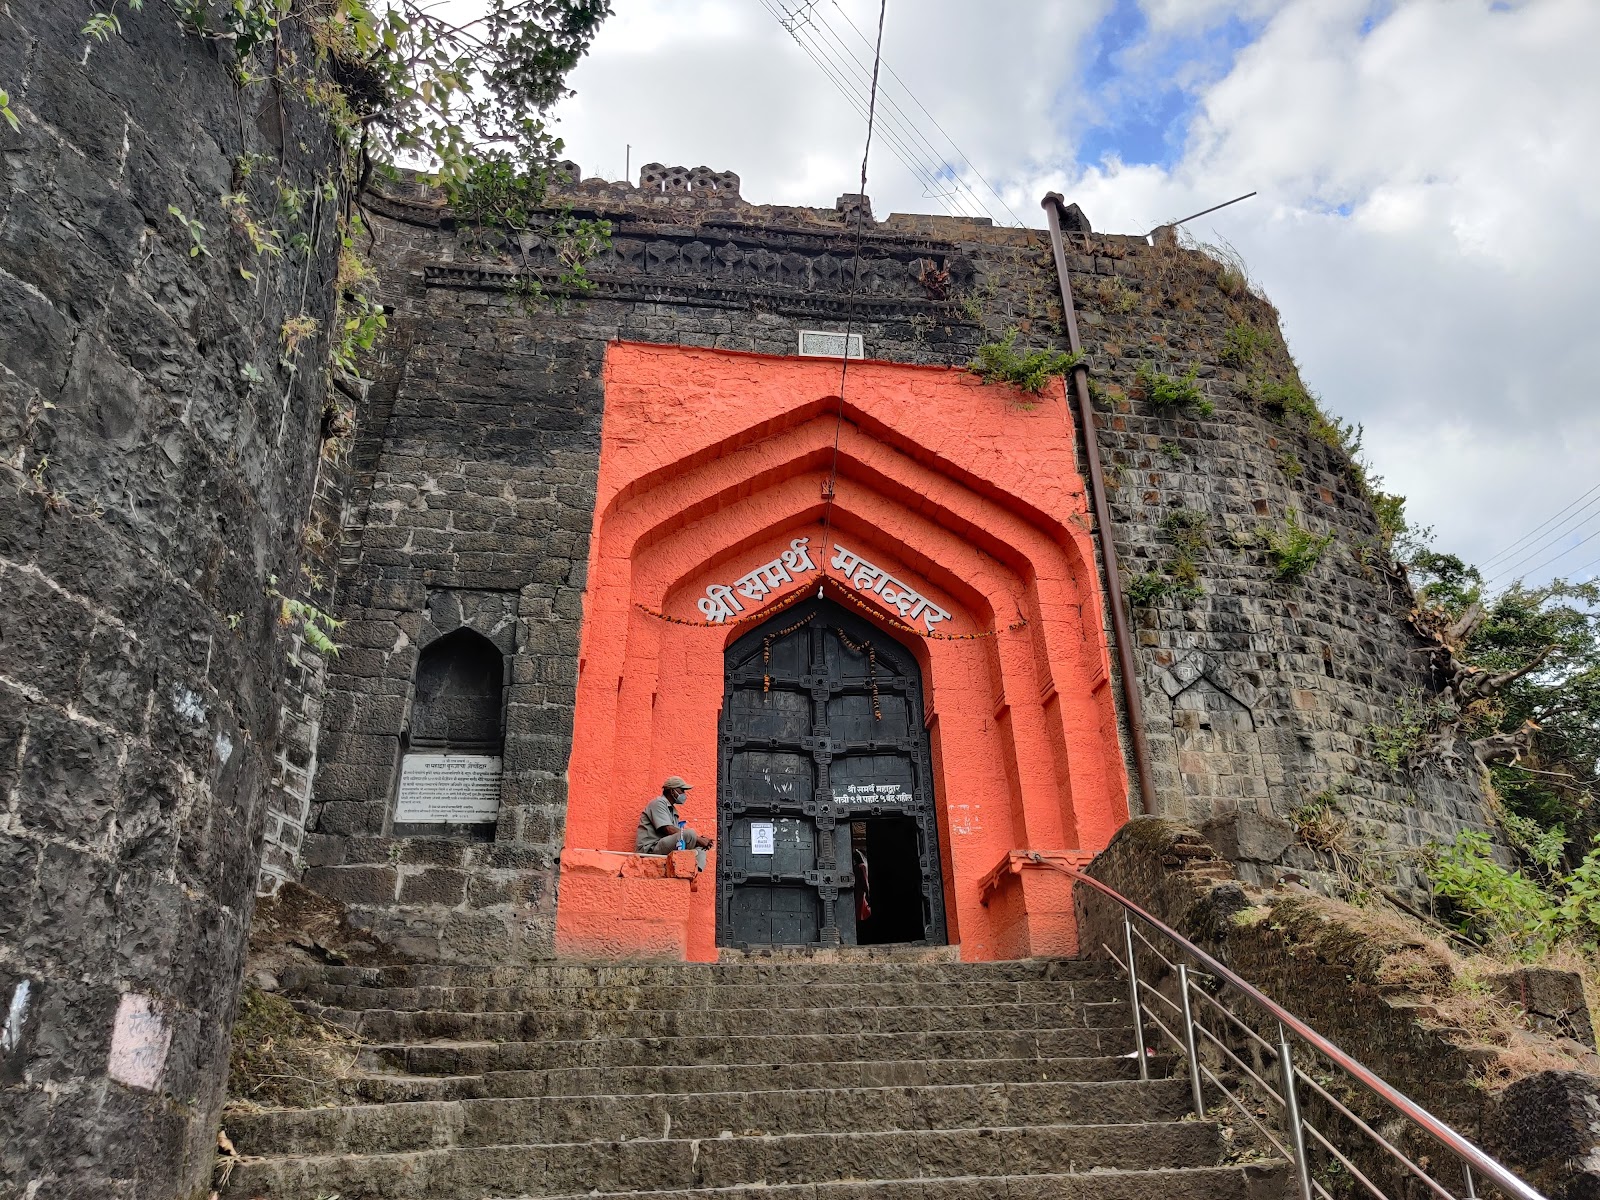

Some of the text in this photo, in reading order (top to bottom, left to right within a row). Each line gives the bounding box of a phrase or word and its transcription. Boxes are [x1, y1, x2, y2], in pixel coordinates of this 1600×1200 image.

[698, 583, 744, 622] श्री
[733, 537, 817, 601] समर्थ
[848, 785, 856, 794] श्री
[857, 784, 875, 793] समर्थ
[834, 794, 849, 804] रात्री
[862, 793, 880, 804] पहाटे
[896, 792, 912, 802] राहील
